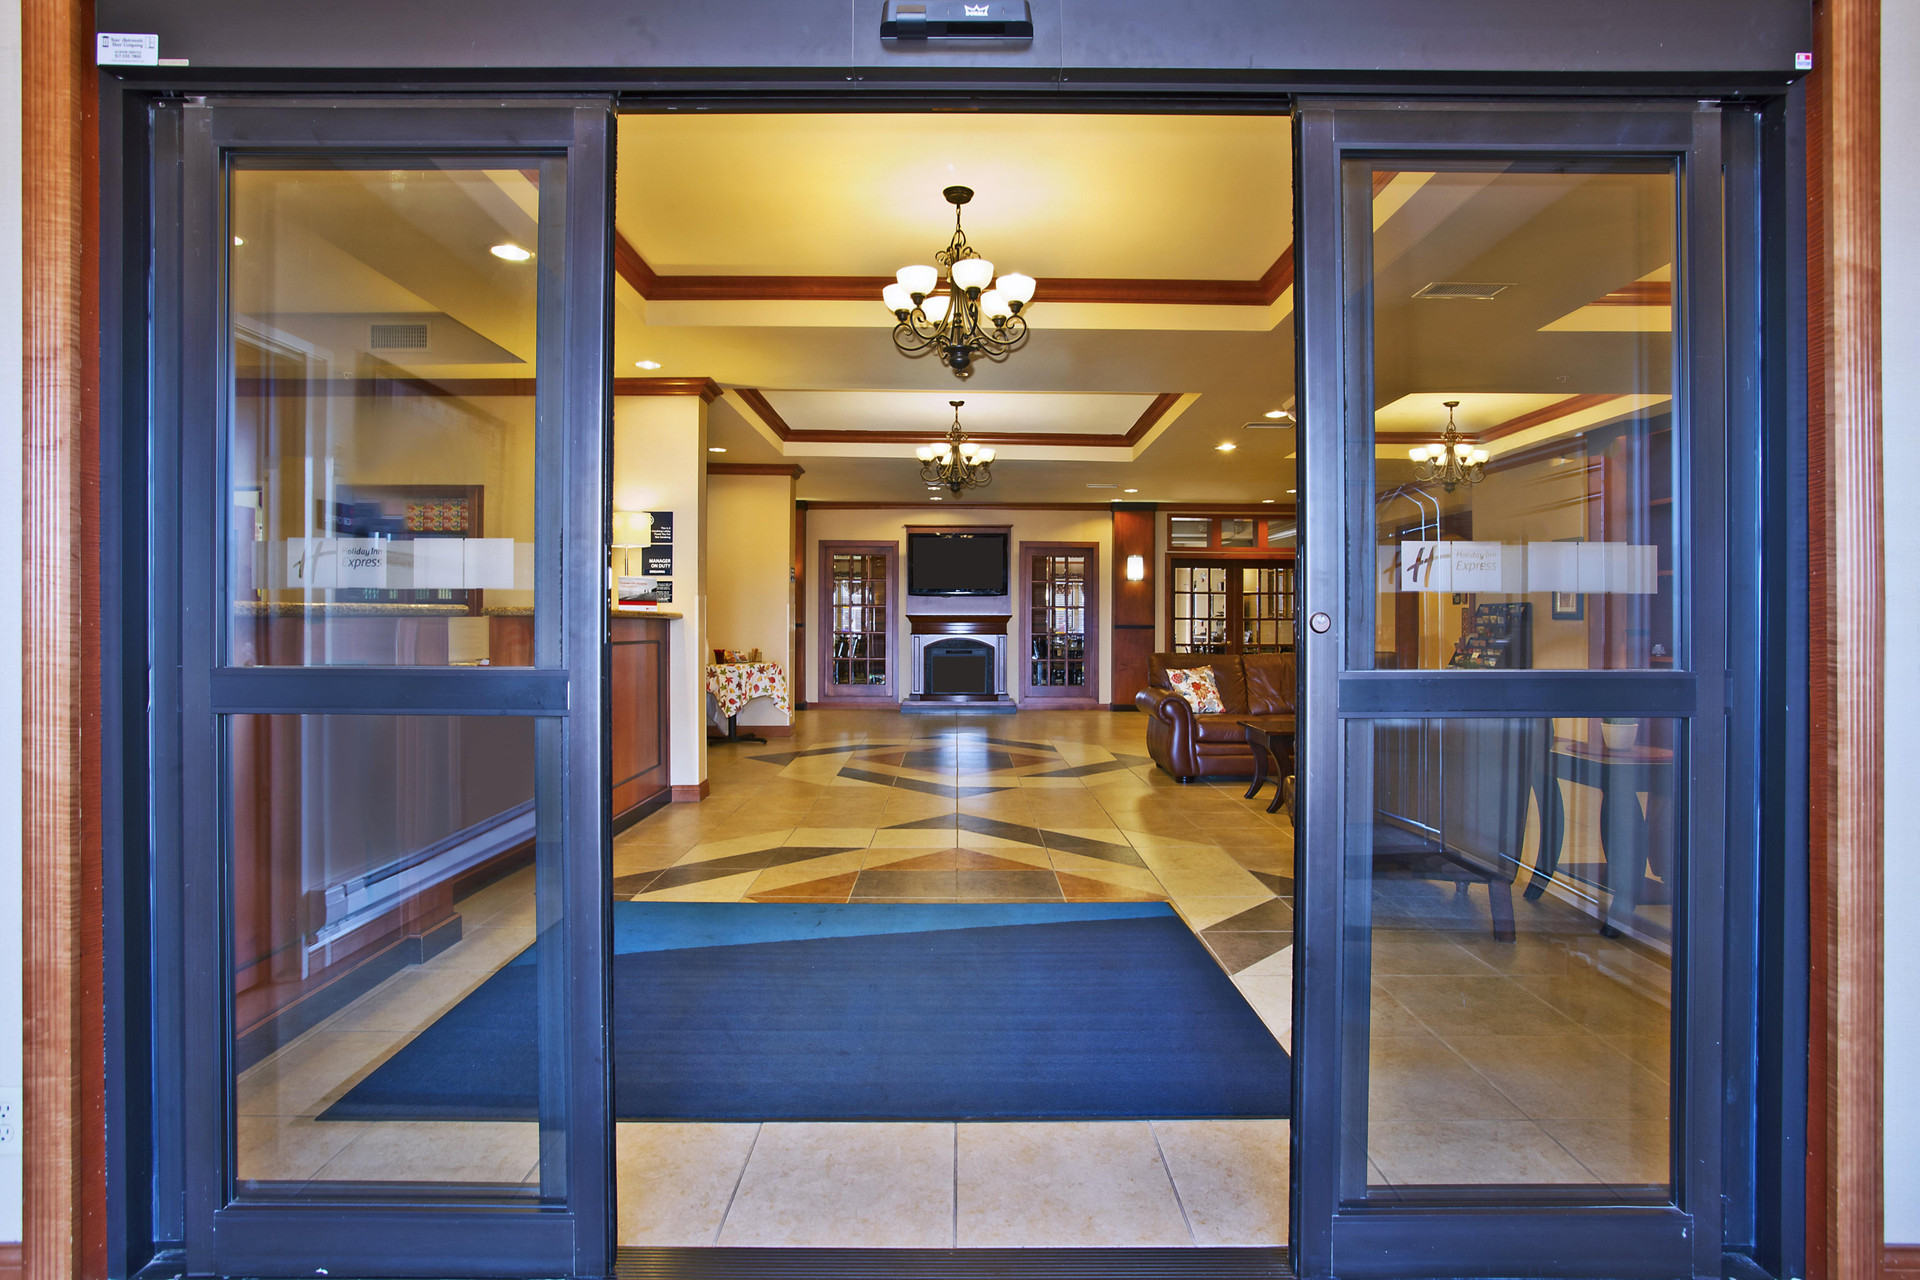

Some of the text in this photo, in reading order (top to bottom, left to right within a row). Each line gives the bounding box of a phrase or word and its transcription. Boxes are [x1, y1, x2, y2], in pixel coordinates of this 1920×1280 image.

[370, 547, 382, 555] Inn
[1456, 550, 1497, 560] Holiday Inn
[342, 558, 383, 570] Express
[1456, 560, 1497, 572] Express
